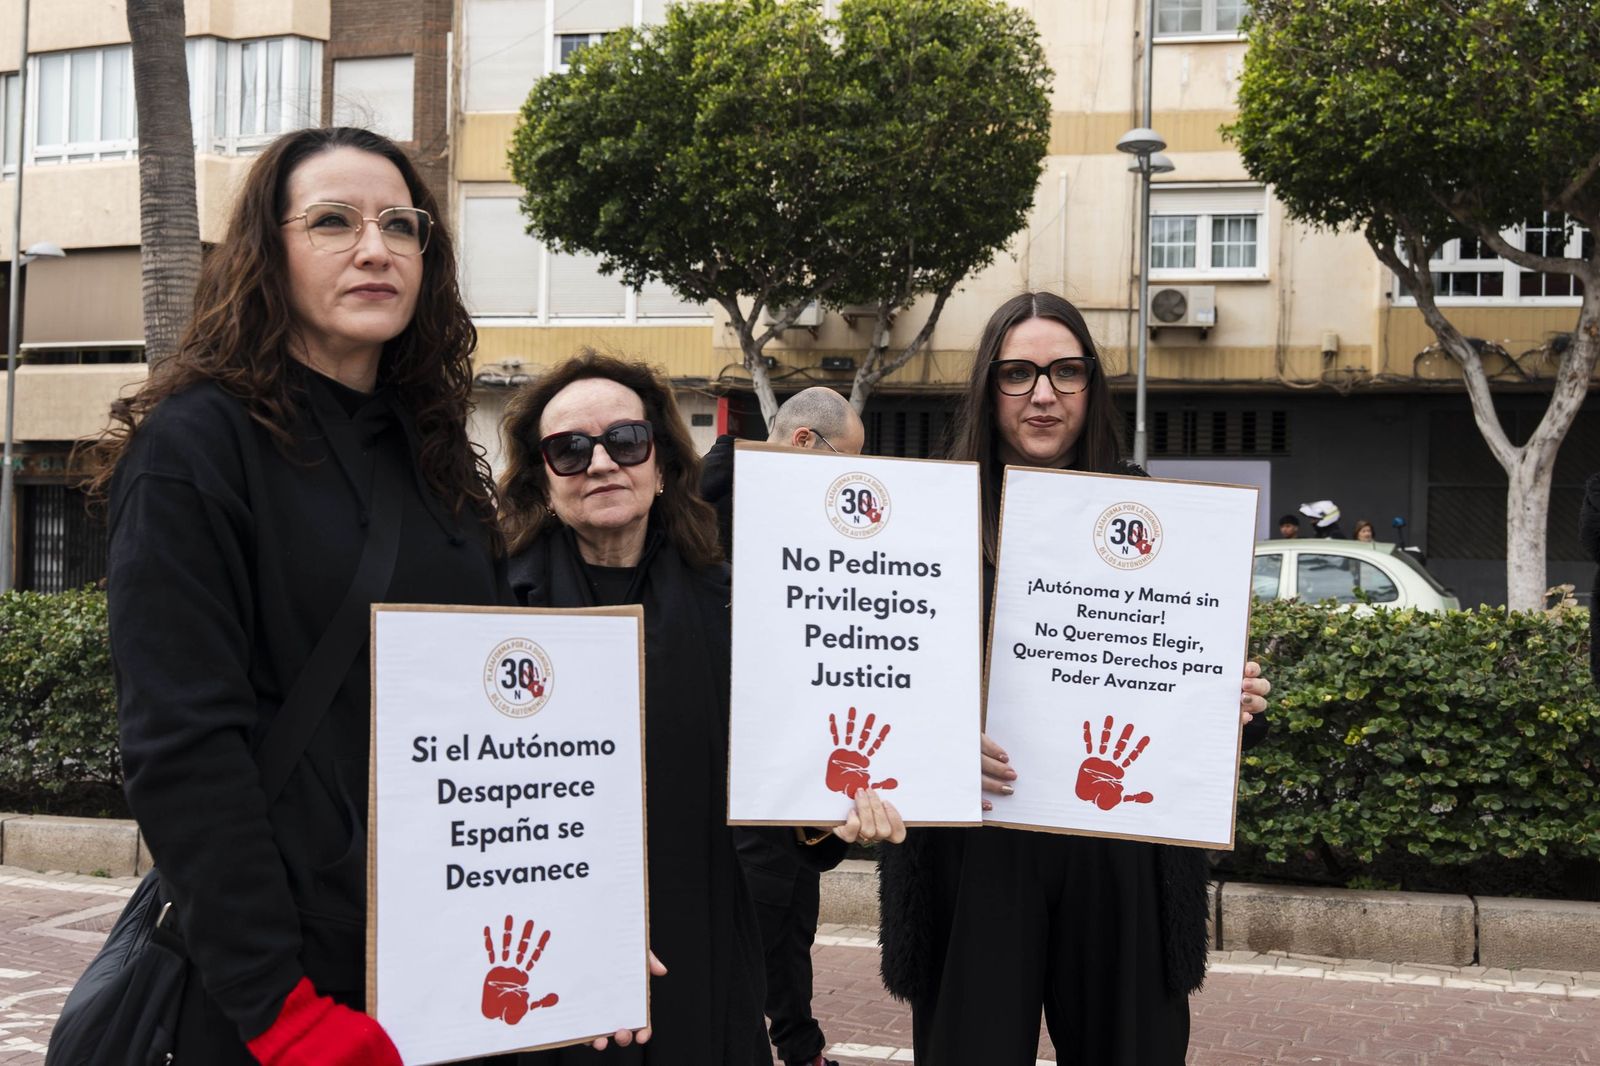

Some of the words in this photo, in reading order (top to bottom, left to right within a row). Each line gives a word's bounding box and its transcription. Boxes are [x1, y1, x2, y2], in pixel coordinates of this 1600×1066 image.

[841, 488, 872, 515] 30
[853, 515, 860, 524] N
[1110, 518, 1144, 546] 30
[782, 547, 820, 572] No
[829, 549, 942, 578] Pedimos
[1121, 546, 1129, 555] N
[787, 585, 936, 620] Privilegios,
[1027, 578, 1120, 599] ¡Autónoma
[1124, 590, 1135, 604] y
[1138, 587, 1192, 605] Mamá
[1196, 593, 1219, 607] sin
[1076, 604, 1166, 625] Renunciar!
[805, 624, 919, 651] Pedimos
[1035, 622, 1058, 638] No
[1062, 625, 1148, 646] Queremos
[1152, 633, 1204, 654] Elegir,
[501, 658, 534, 689] 30
[1013, 643, 1098, 663] Queremos
[1102, 650, 1178, 671] Derechos
[1182, 662, 1223, 675] para
[811, 662, 911, 689] Justicia
[1051, 668, 1100, 686] Poder
[1103, 673, 1177, 693] Avanzar
[514, 689, 521, 700] N
[411, 736, 437, 763] Si
[446, 734, 469, 761] el
[477, 733, 616, 760] Autónomo
[438, 778, 595, 809] Desaparece
[451, 817, 549, 852] España
[558, 821, 585, 839] se
[446, 861, 590, 890] Desvanece
